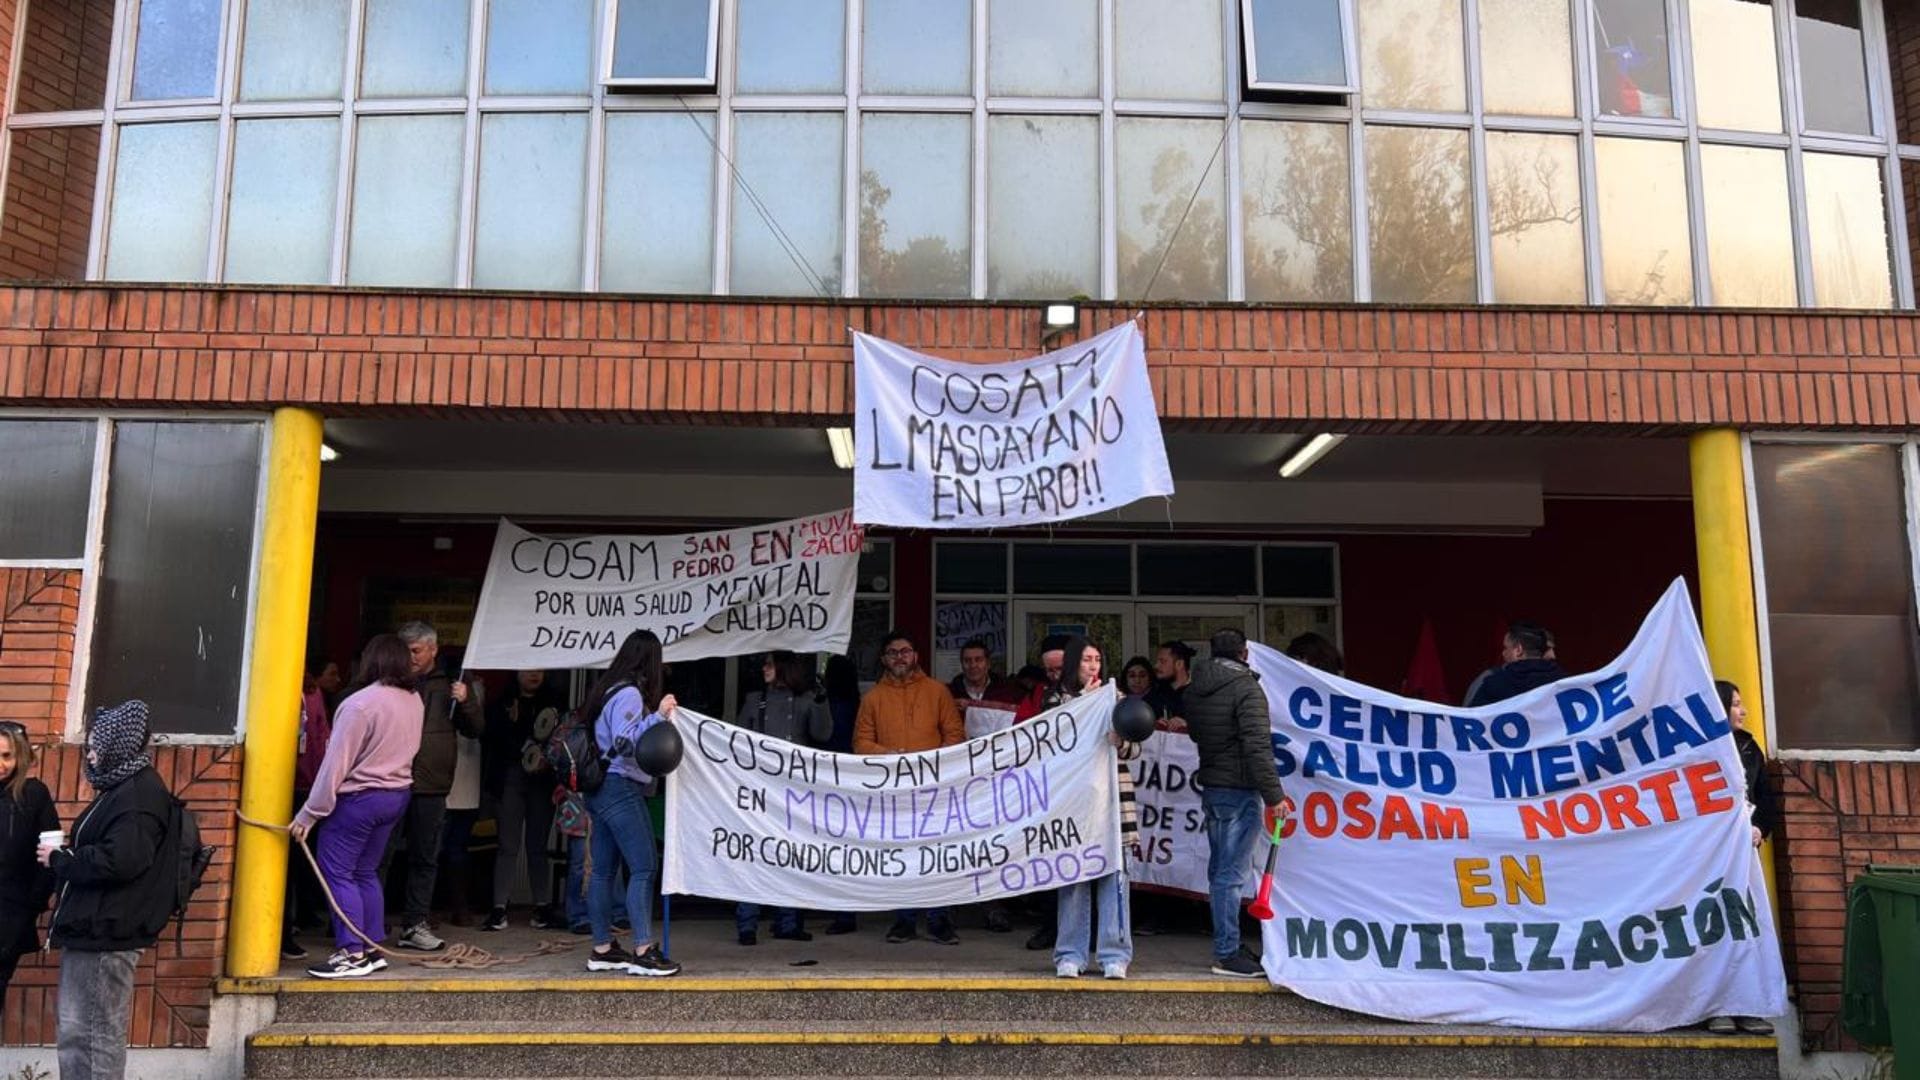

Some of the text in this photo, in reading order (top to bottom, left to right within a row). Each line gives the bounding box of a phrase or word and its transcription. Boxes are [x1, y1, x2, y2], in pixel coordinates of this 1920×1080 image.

[911, 348, 1097, 418] COSAM
[871, 395, 1123, 476] L MASCAYANO
[932, 458, 1105, 521] EN PARO!!
[511, 511, 859, 582] COSAM SAN EN MOVI
[672, 553, 735, 578] PEDRO
[535, 561, 831, 617] POR UNA SALUD MENTAL
[531, 626, 616, 651] DIGNA
[704, 602, 828, 633] CALIDAD
[1271, 692, 1734, 799] SALUD MENTAL
[1289, 671, 1635, 752] CENTRO DE
[697, 711, 1077, 790] COSAM SAN PEDRO
[737, 763, 1050, 841] EN MOVILIZACIÓN
[1142, 804, 1174, 830] DE
[1265, 760, 1735, 841] COSAM NORTE
[712, 816, 1083, 877] POR CONDICIONES DIGNAS PARA
[964, 845, 1108, 897] TODOS
[1453, 854, 1546, 908] EN
[1285, 877, 1761, 972] MOVILIZACIÓN
